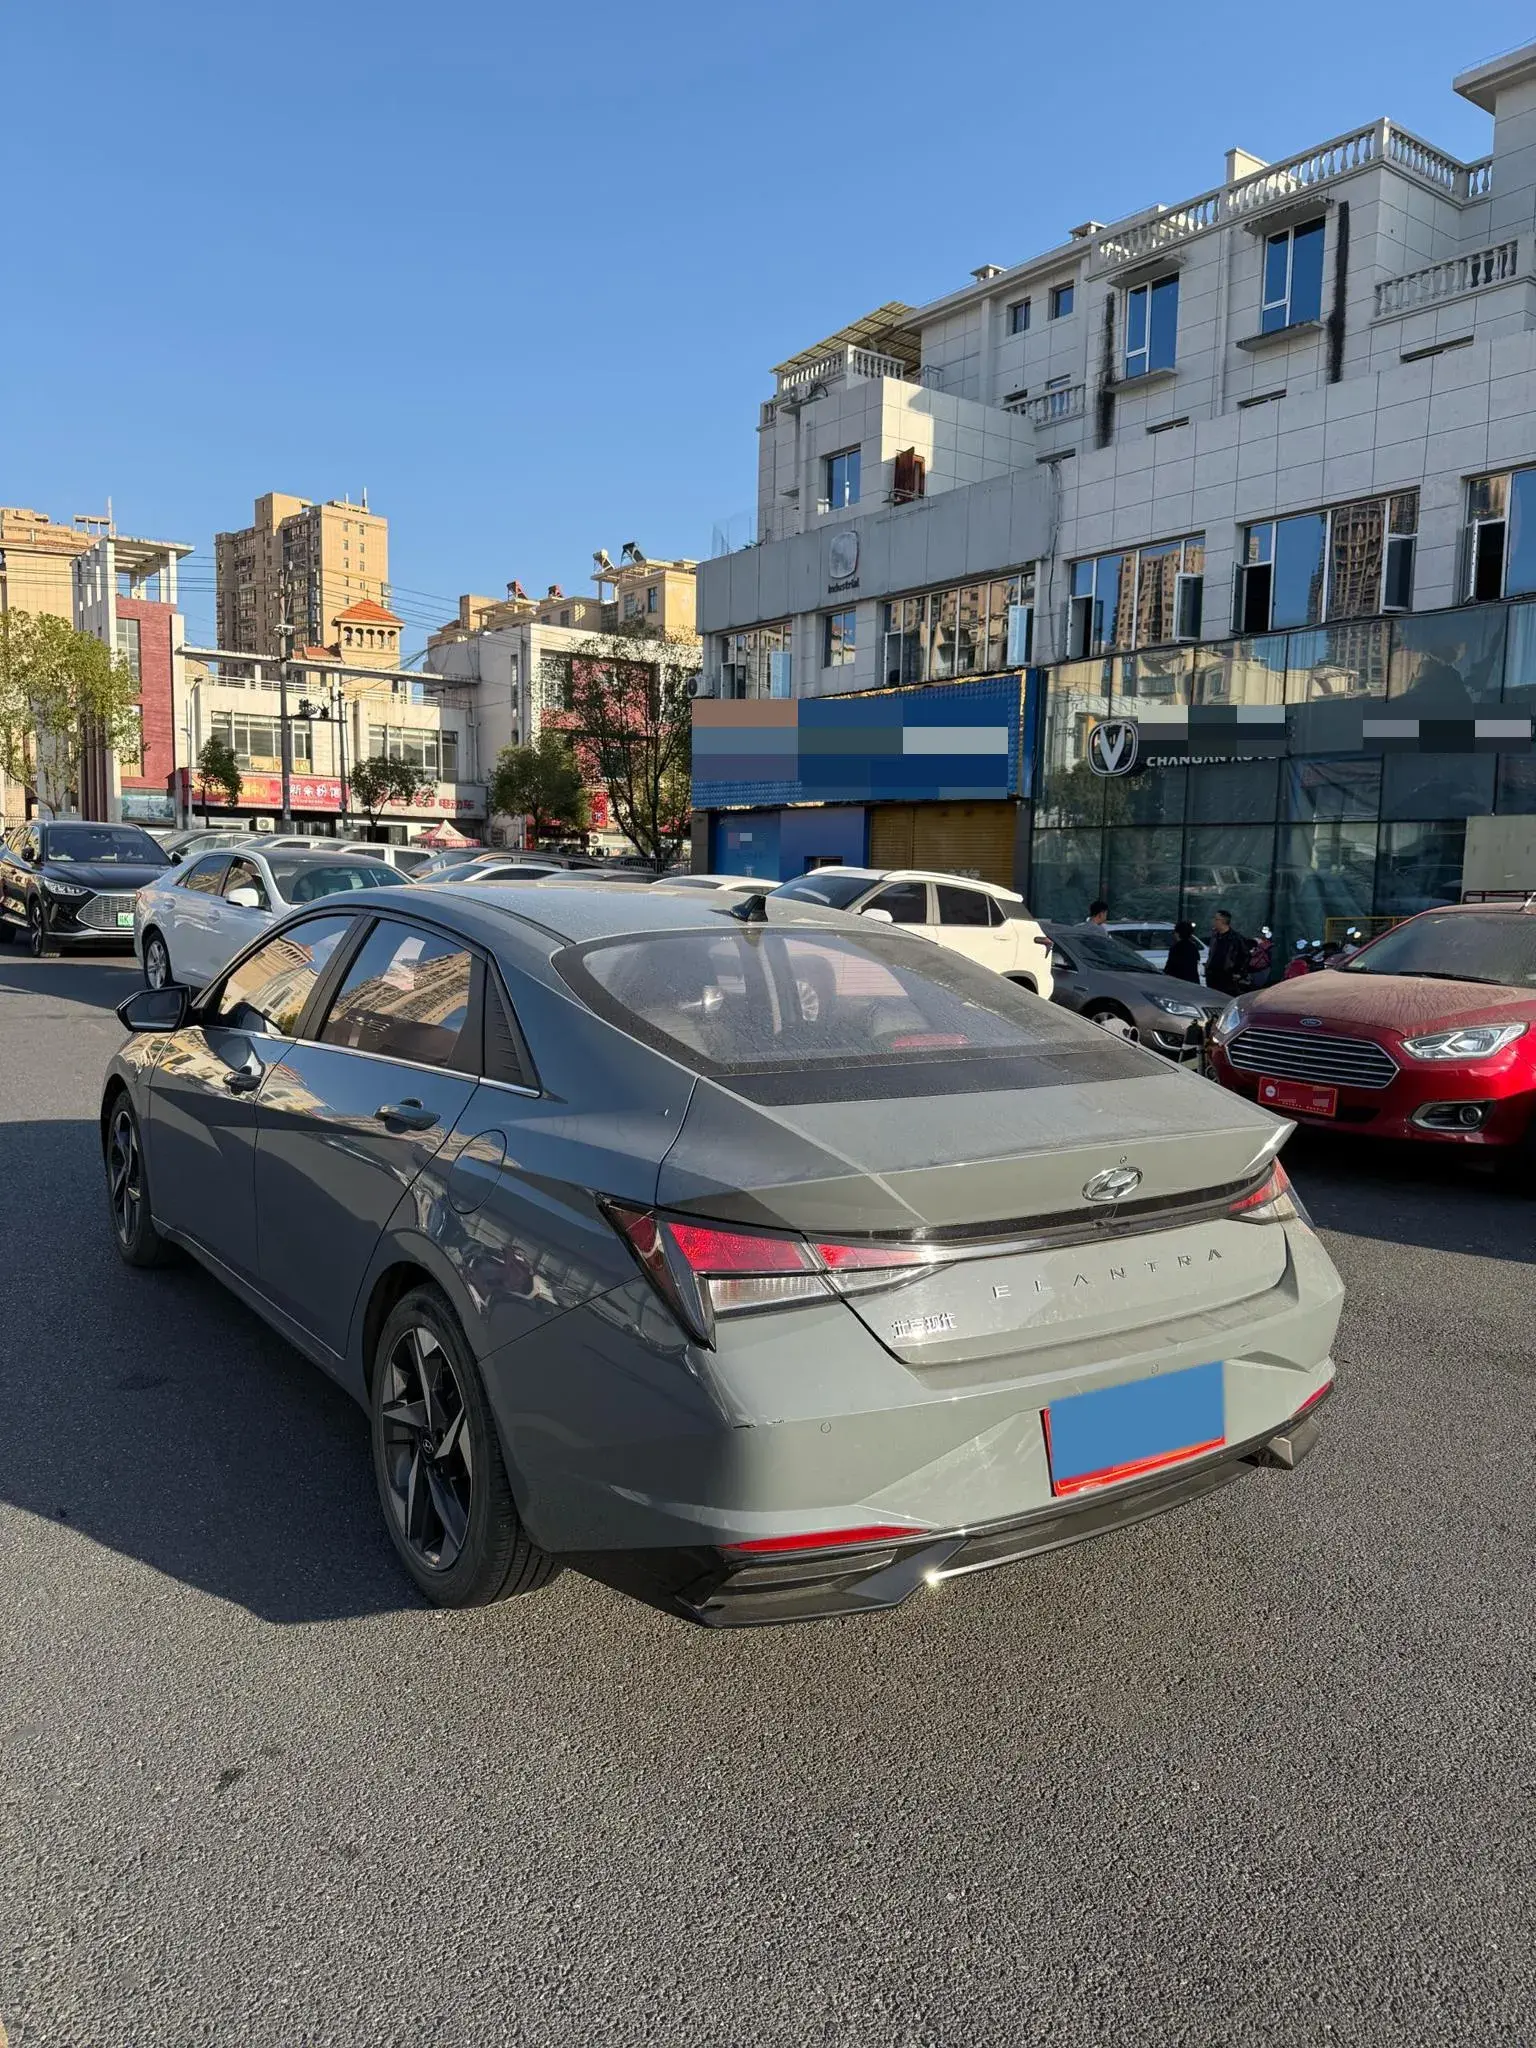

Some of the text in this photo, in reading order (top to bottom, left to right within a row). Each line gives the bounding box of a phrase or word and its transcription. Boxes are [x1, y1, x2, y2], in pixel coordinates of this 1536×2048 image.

[828, 577, 859, 594] Industrial
[991, 1248, 1222, 1300] ELANTRA
[891, 1312, 958, 1339] 北京现代
